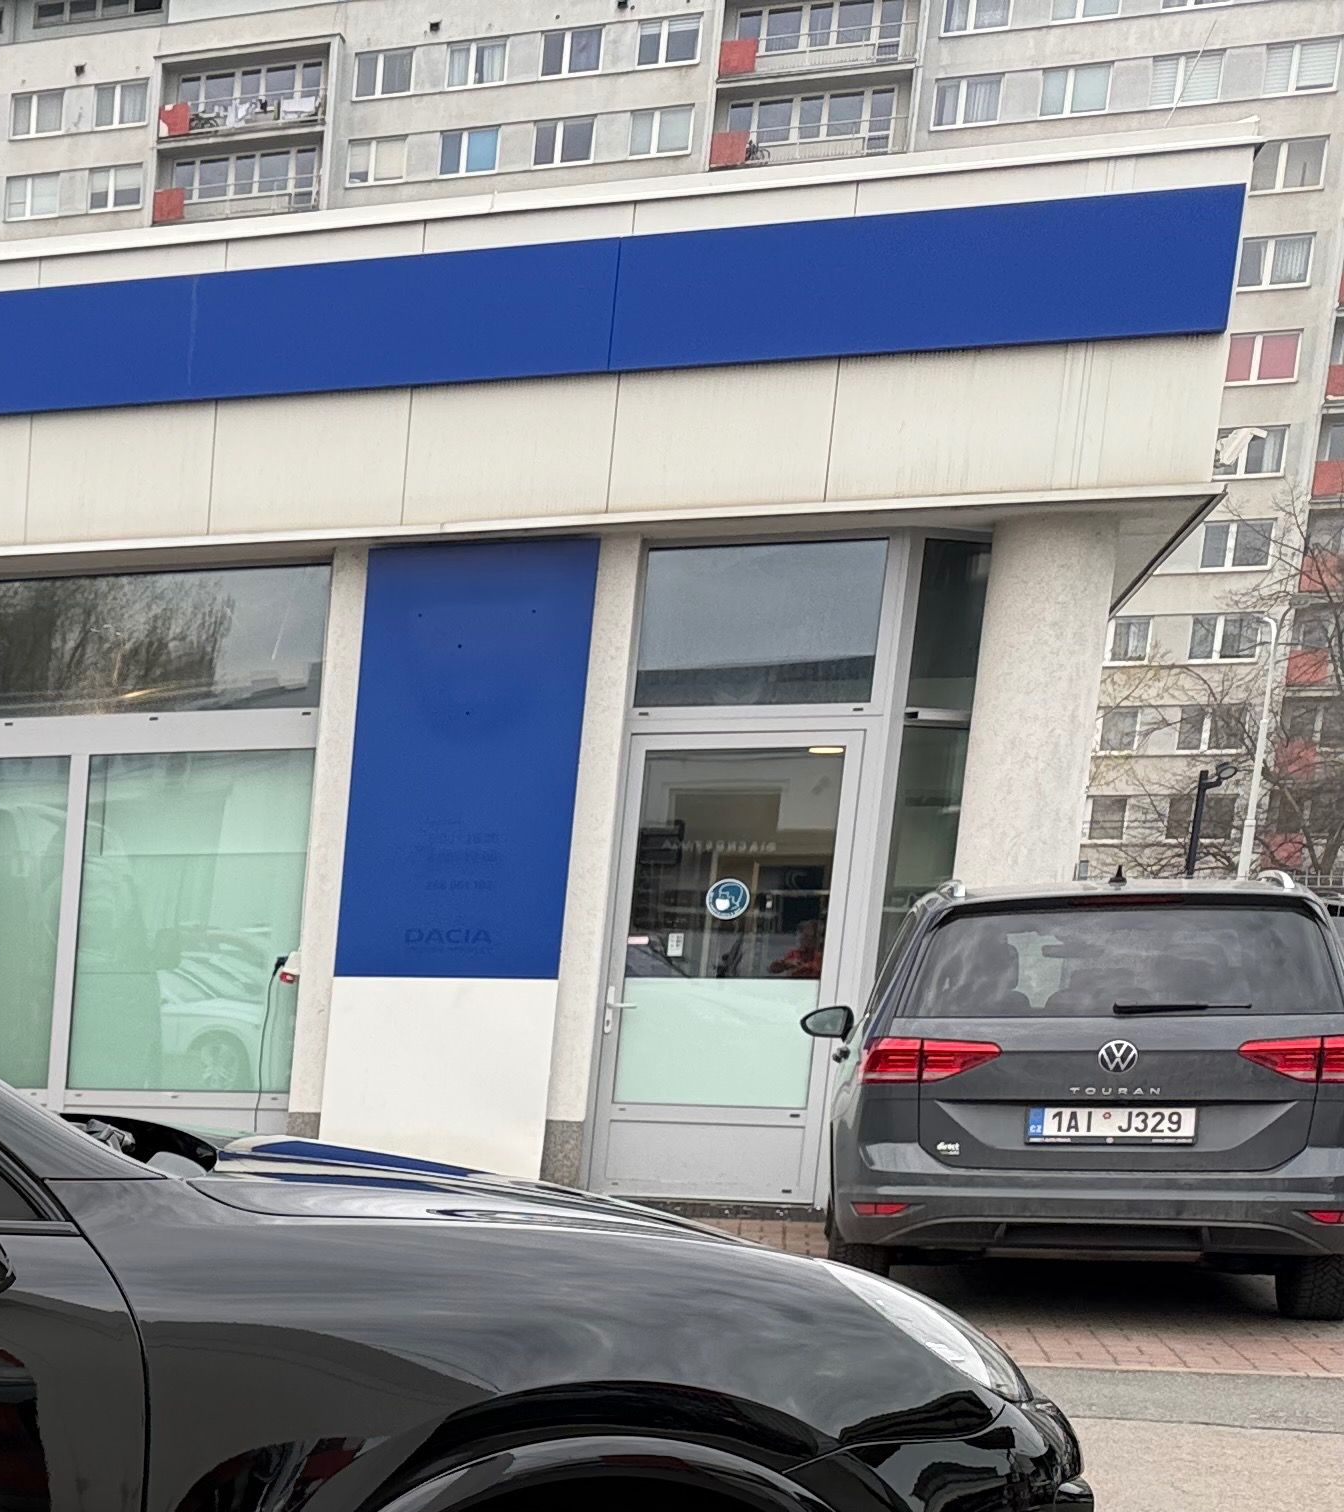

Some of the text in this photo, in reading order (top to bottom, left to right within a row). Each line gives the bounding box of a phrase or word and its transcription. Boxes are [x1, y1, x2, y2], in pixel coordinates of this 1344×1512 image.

[405, 928, 492, 944] DACIA
[1069, 1086, 1161, 1096] TOURAN
[1052, 1111, 1093, 1133] 1AI
[1118, 1111, 1183, 1133] J329
